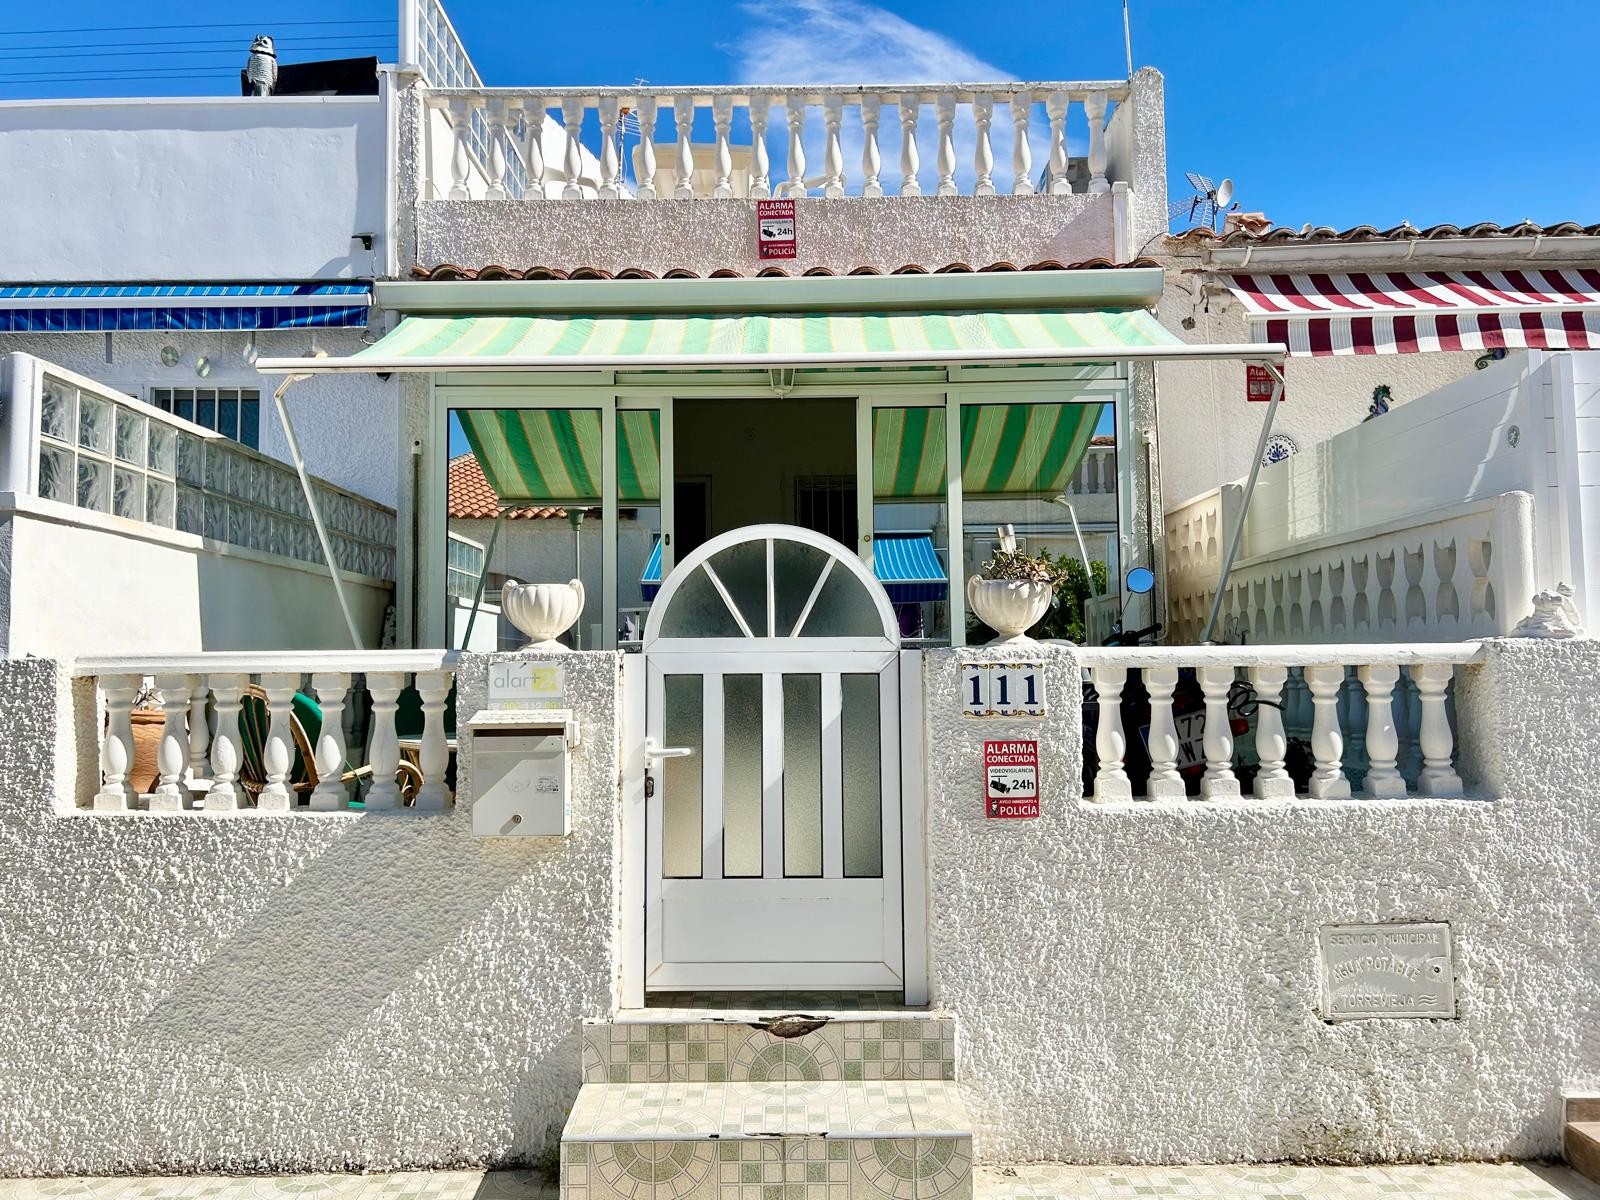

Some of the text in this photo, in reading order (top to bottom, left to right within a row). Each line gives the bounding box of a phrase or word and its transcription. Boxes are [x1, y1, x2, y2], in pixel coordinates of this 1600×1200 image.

[760, 202, 794, 210] ALARMA
[777, 228, 793, 236] 24h
[969, 674, 1039, 706] 111
[986, 743, 1036, 754] ALARMA
[986, 755, 1036, 763] CONECTADA
[1012, 779, 1035, 790] 24h
[1000, 804, 1038, 815] POLICÍA
[1330, 933, 1440, 946] SERVICIO MUNICIPAL
[1366, 956, 1422, 983] POTABLE
[1340, 994, 1415, 1008] TORREVIEJA
